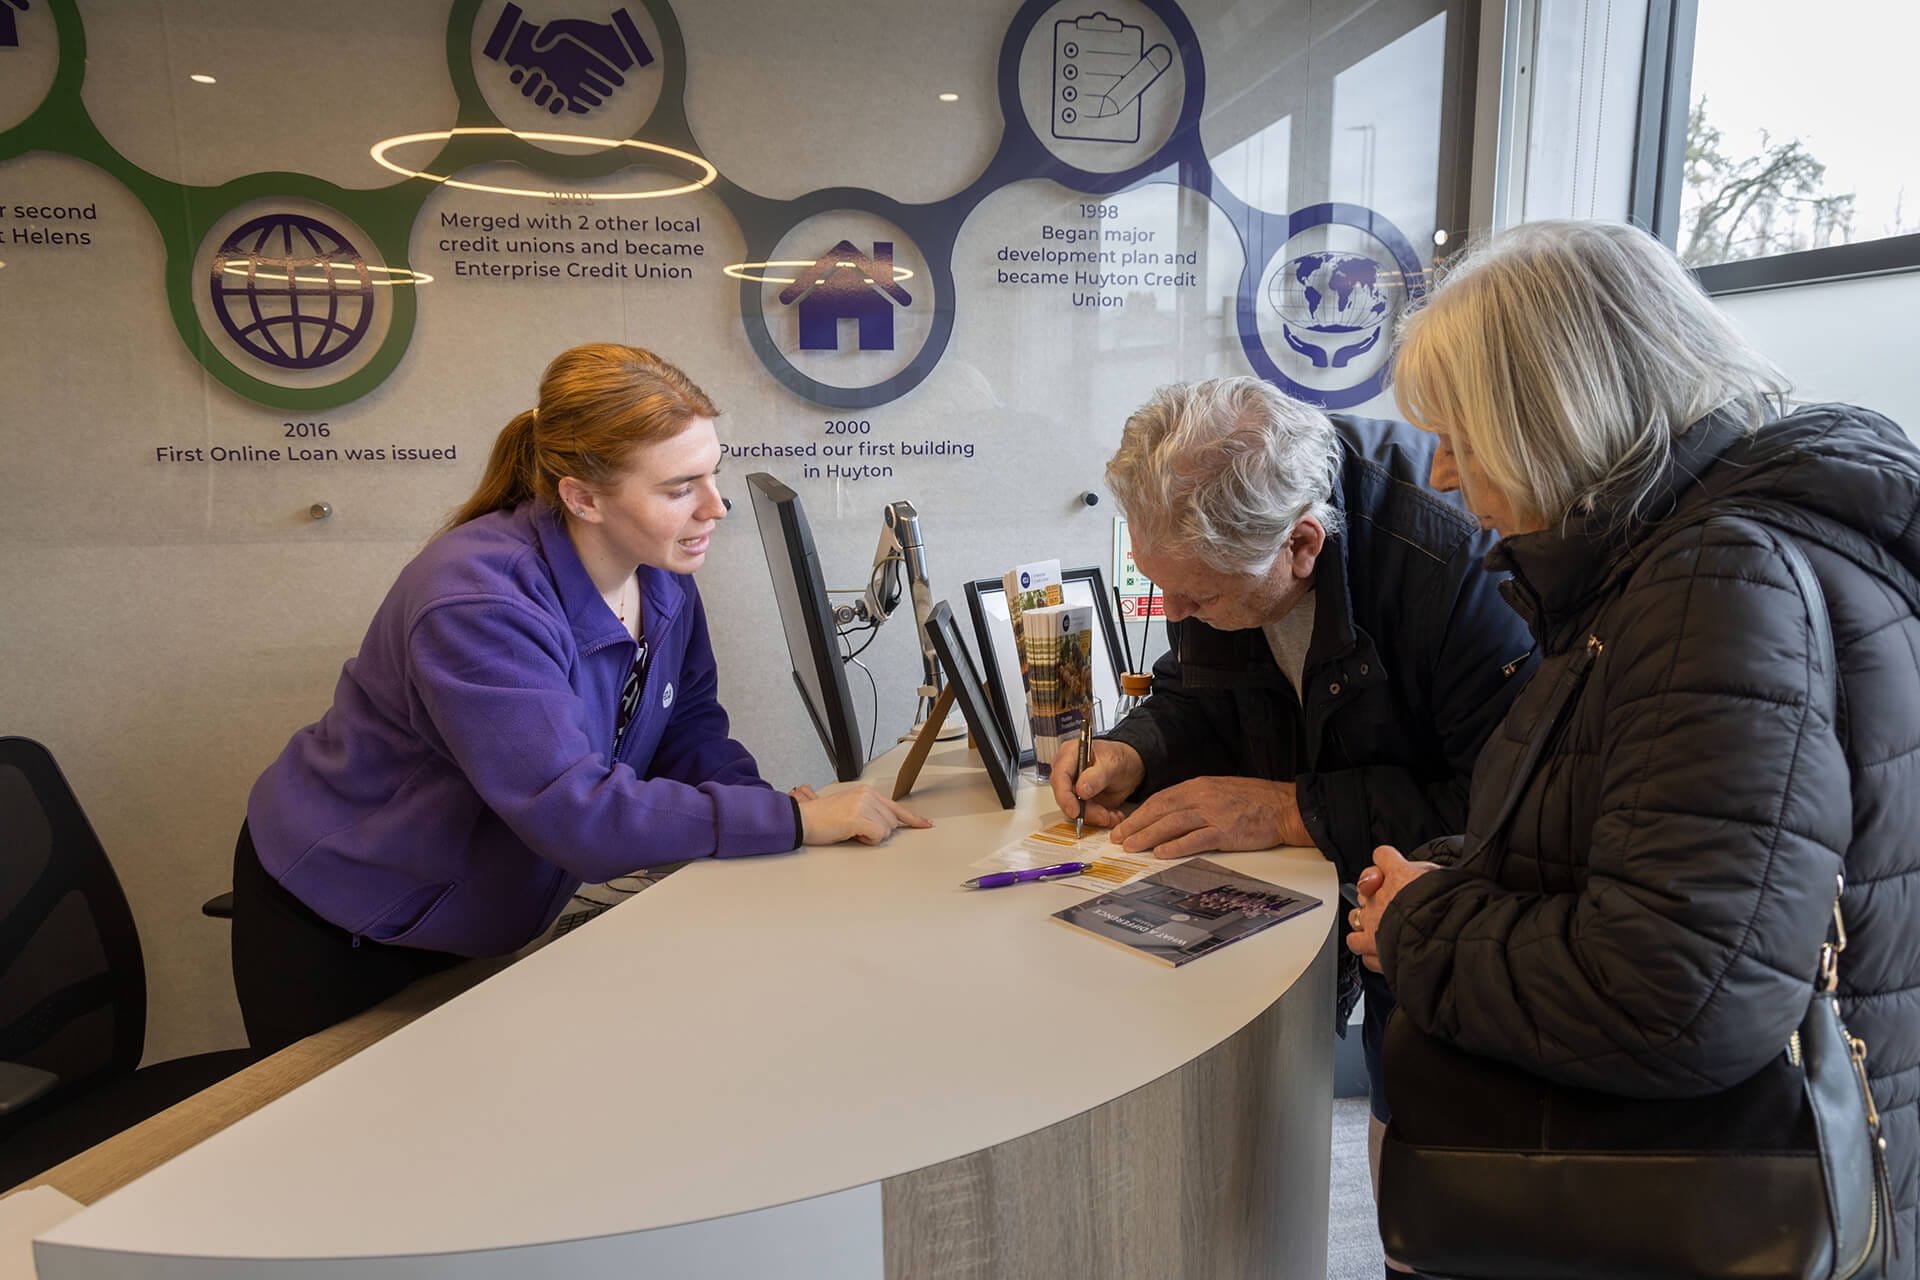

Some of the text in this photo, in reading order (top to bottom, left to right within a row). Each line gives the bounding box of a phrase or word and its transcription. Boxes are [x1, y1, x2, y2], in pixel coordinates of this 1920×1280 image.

[13, 203, 97, 220] second
[1079, 203, 1119, 219] 1998
[440, 212, 701, 233] Merged with 2 other local
[12, 227, 92, 246] Helens
[1042, 225, 1156, 246] Began major
[439, 235, 705, 256] credit unions and became
[997, 245, 1197, 268] development plan and
[455, 260, 693, 281] Enterprise Credit Union
[997, 268, 1197, 289] became Huyton Credit
[1072, 291, 1124, 308] Union
[283, 422, 331, 438] 2016
[824, 420, 871, 435] 2000
[156, 444, 457, 462] First Online Loan was issued
[719, 439, 975, 458] Purchased our first building
[803, 463, 893, 482] in Huyton
